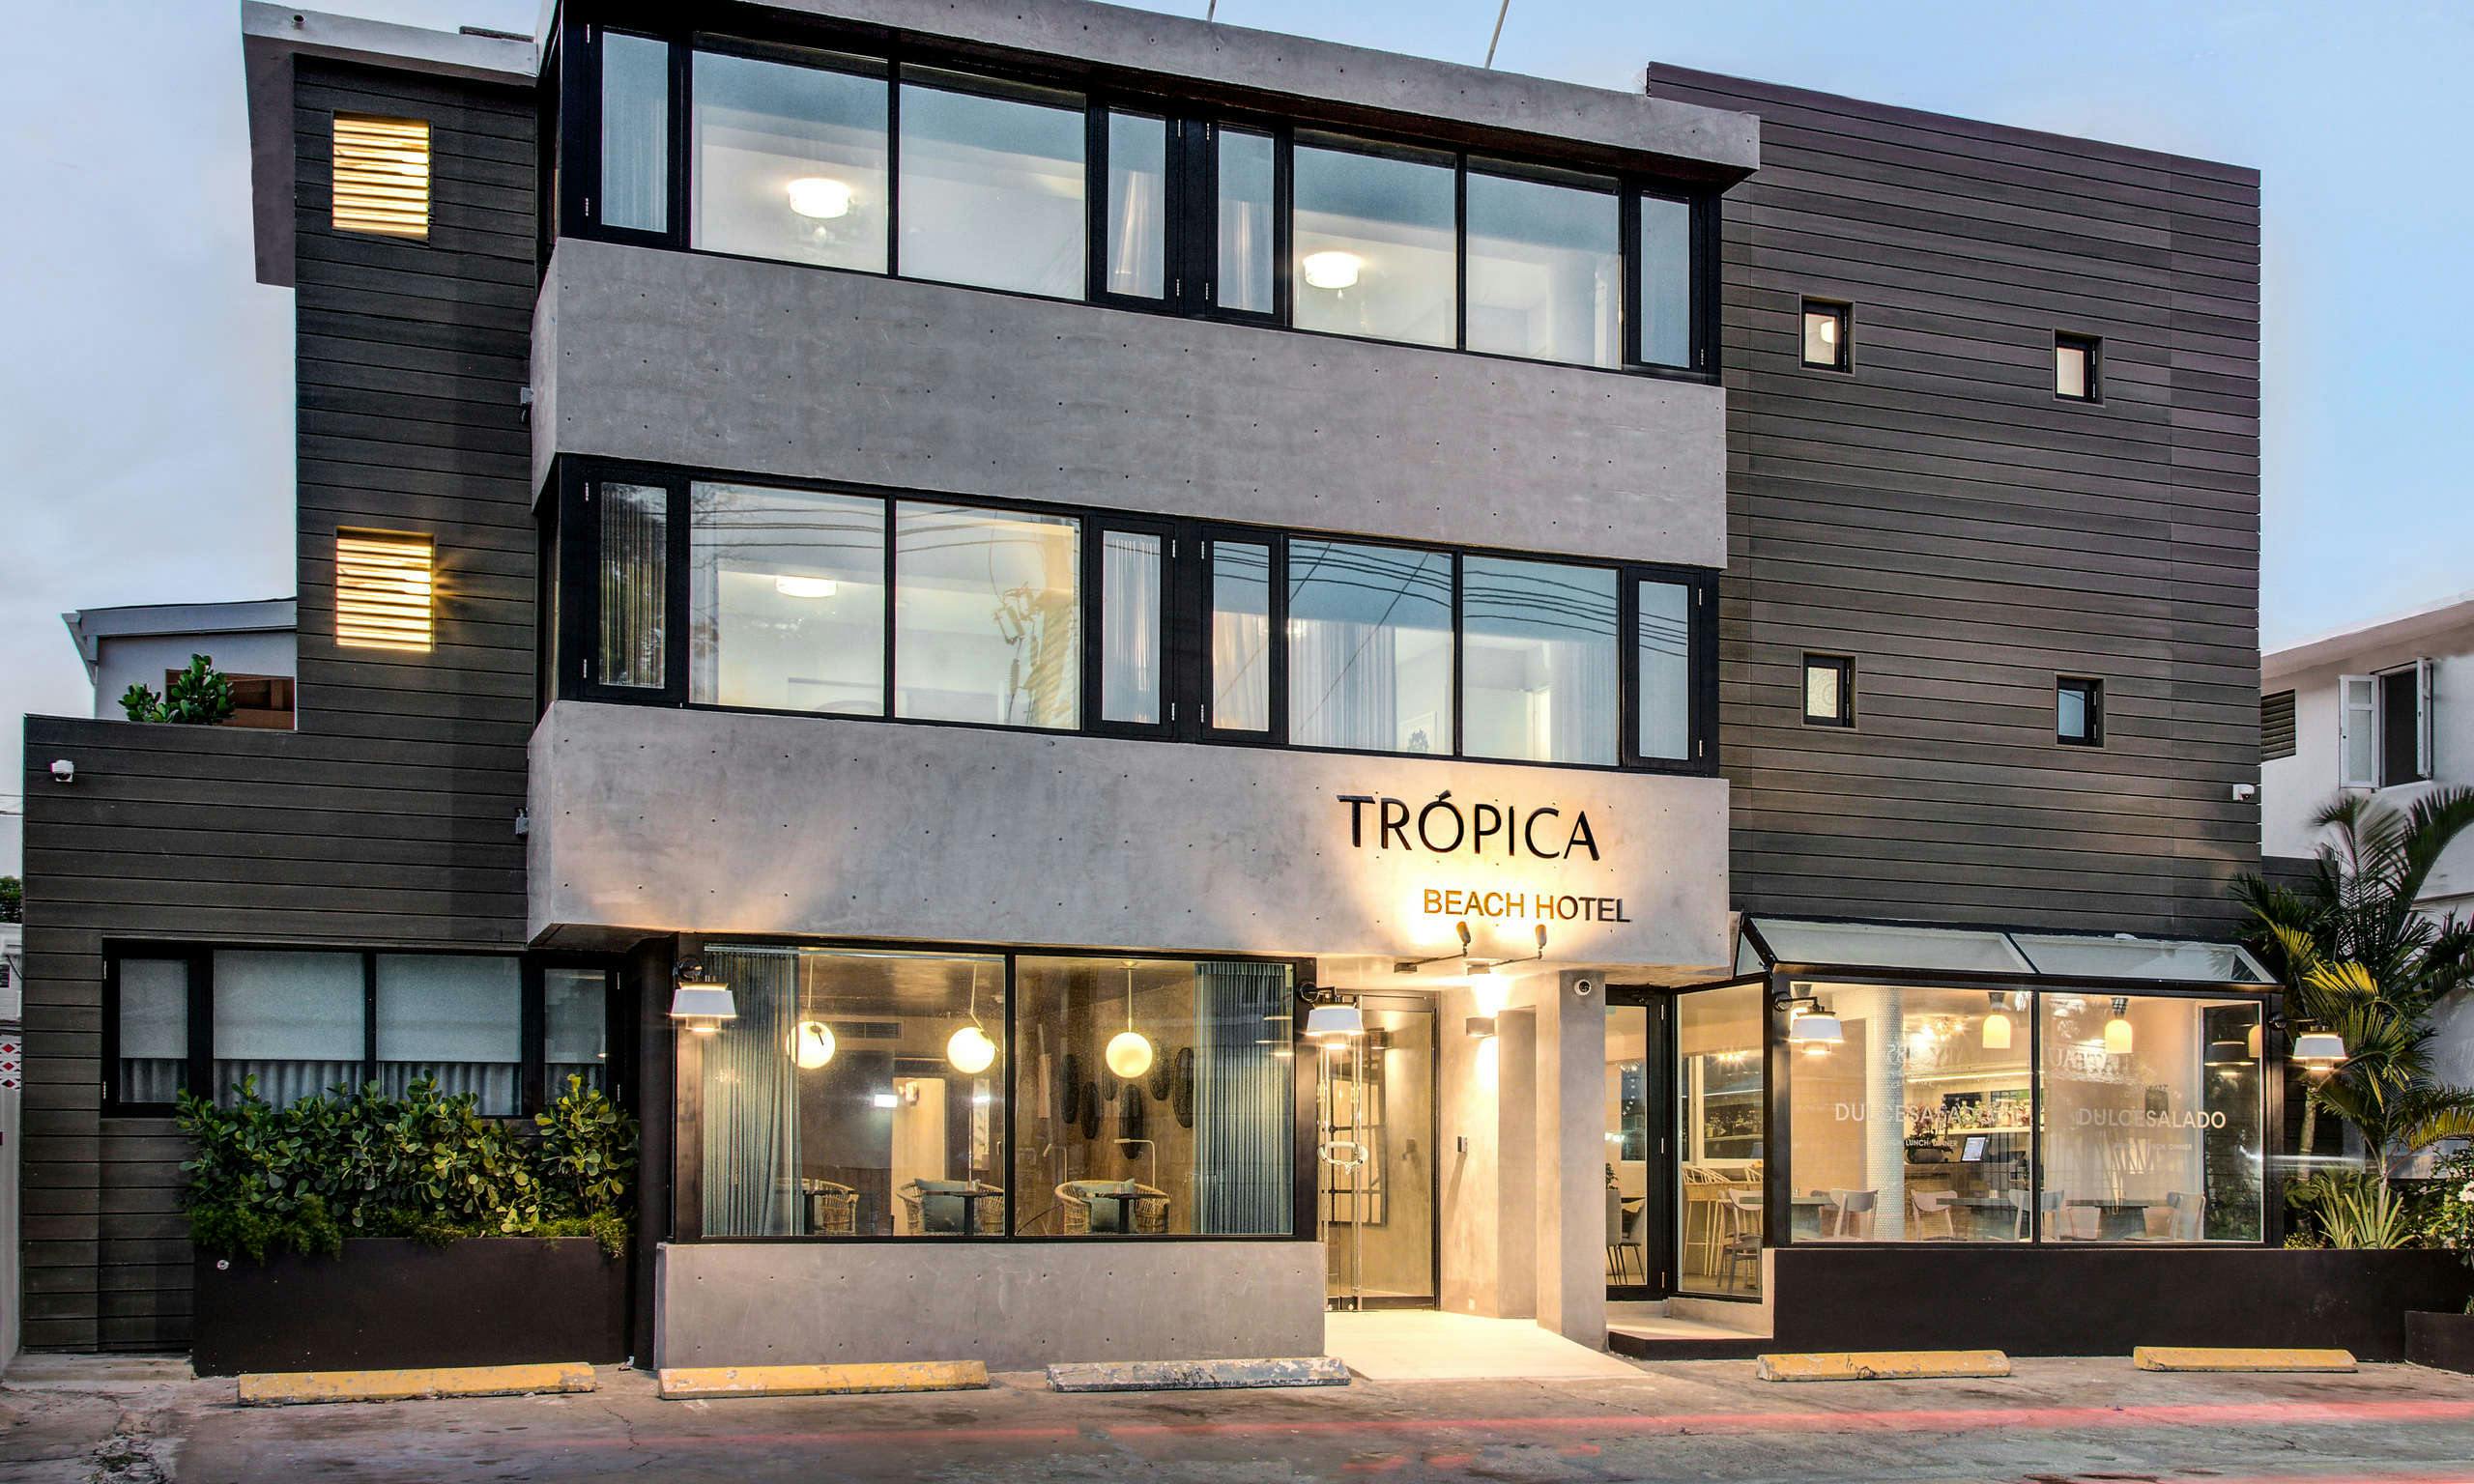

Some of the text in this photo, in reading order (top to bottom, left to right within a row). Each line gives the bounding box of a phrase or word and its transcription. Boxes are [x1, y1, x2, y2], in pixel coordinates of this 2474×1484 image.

[1337, 789, 1600, 861] TRÓPICA
[1424, 888, 1631, 923] BEACH HOTEL
[1835, 1102, 1997, 1124] DULCESAAD
[2079, 1107, 2227, 1129] DULCESALADO
